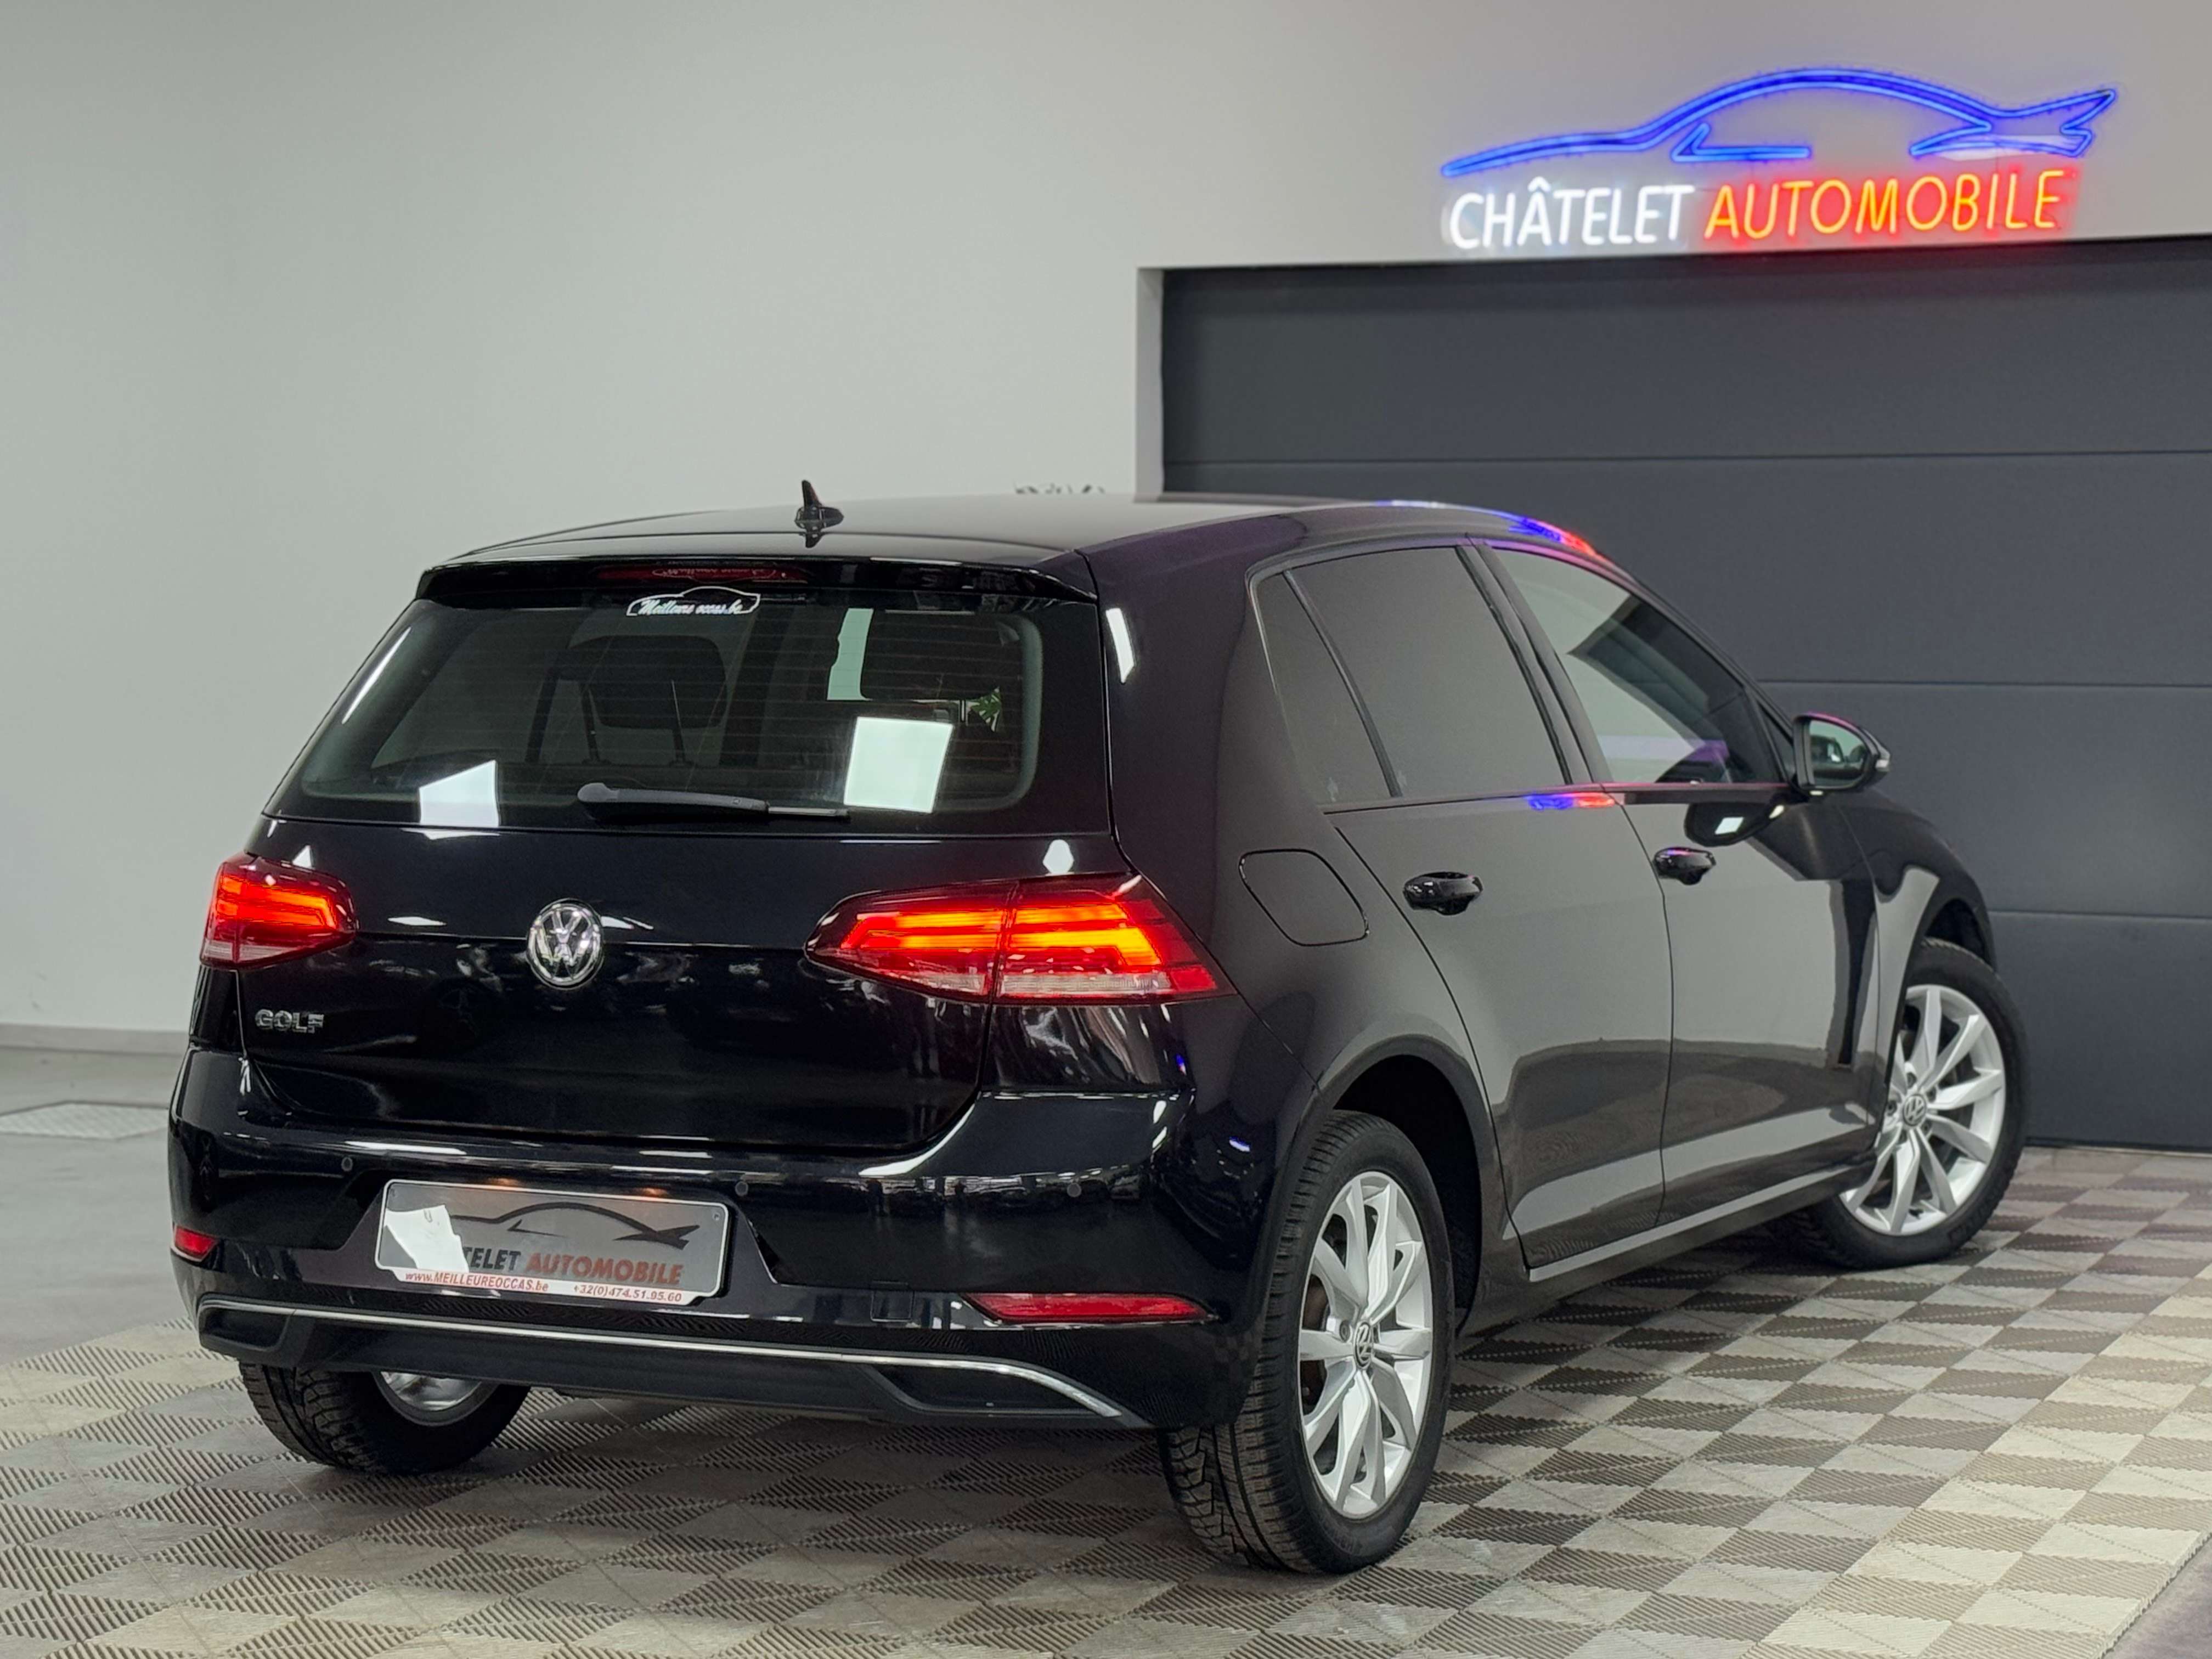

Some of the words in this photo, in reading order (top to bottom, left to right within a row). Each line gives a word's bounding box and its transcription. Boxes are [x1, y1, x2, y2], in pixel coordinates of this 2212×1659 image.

[1448, 176, 1695, 250] CHÂTELET
[1703, 169, 2066, 239] AUTOMOBILE
[255, 1009, 324, 1034] GOLF
[462, 1246, 521, 1271] TELET
[525, 1252, 684, 1285] AUTOMOBILE
[405, 1272, 549, 1292] www.MEILLEUREOCCAS.be
